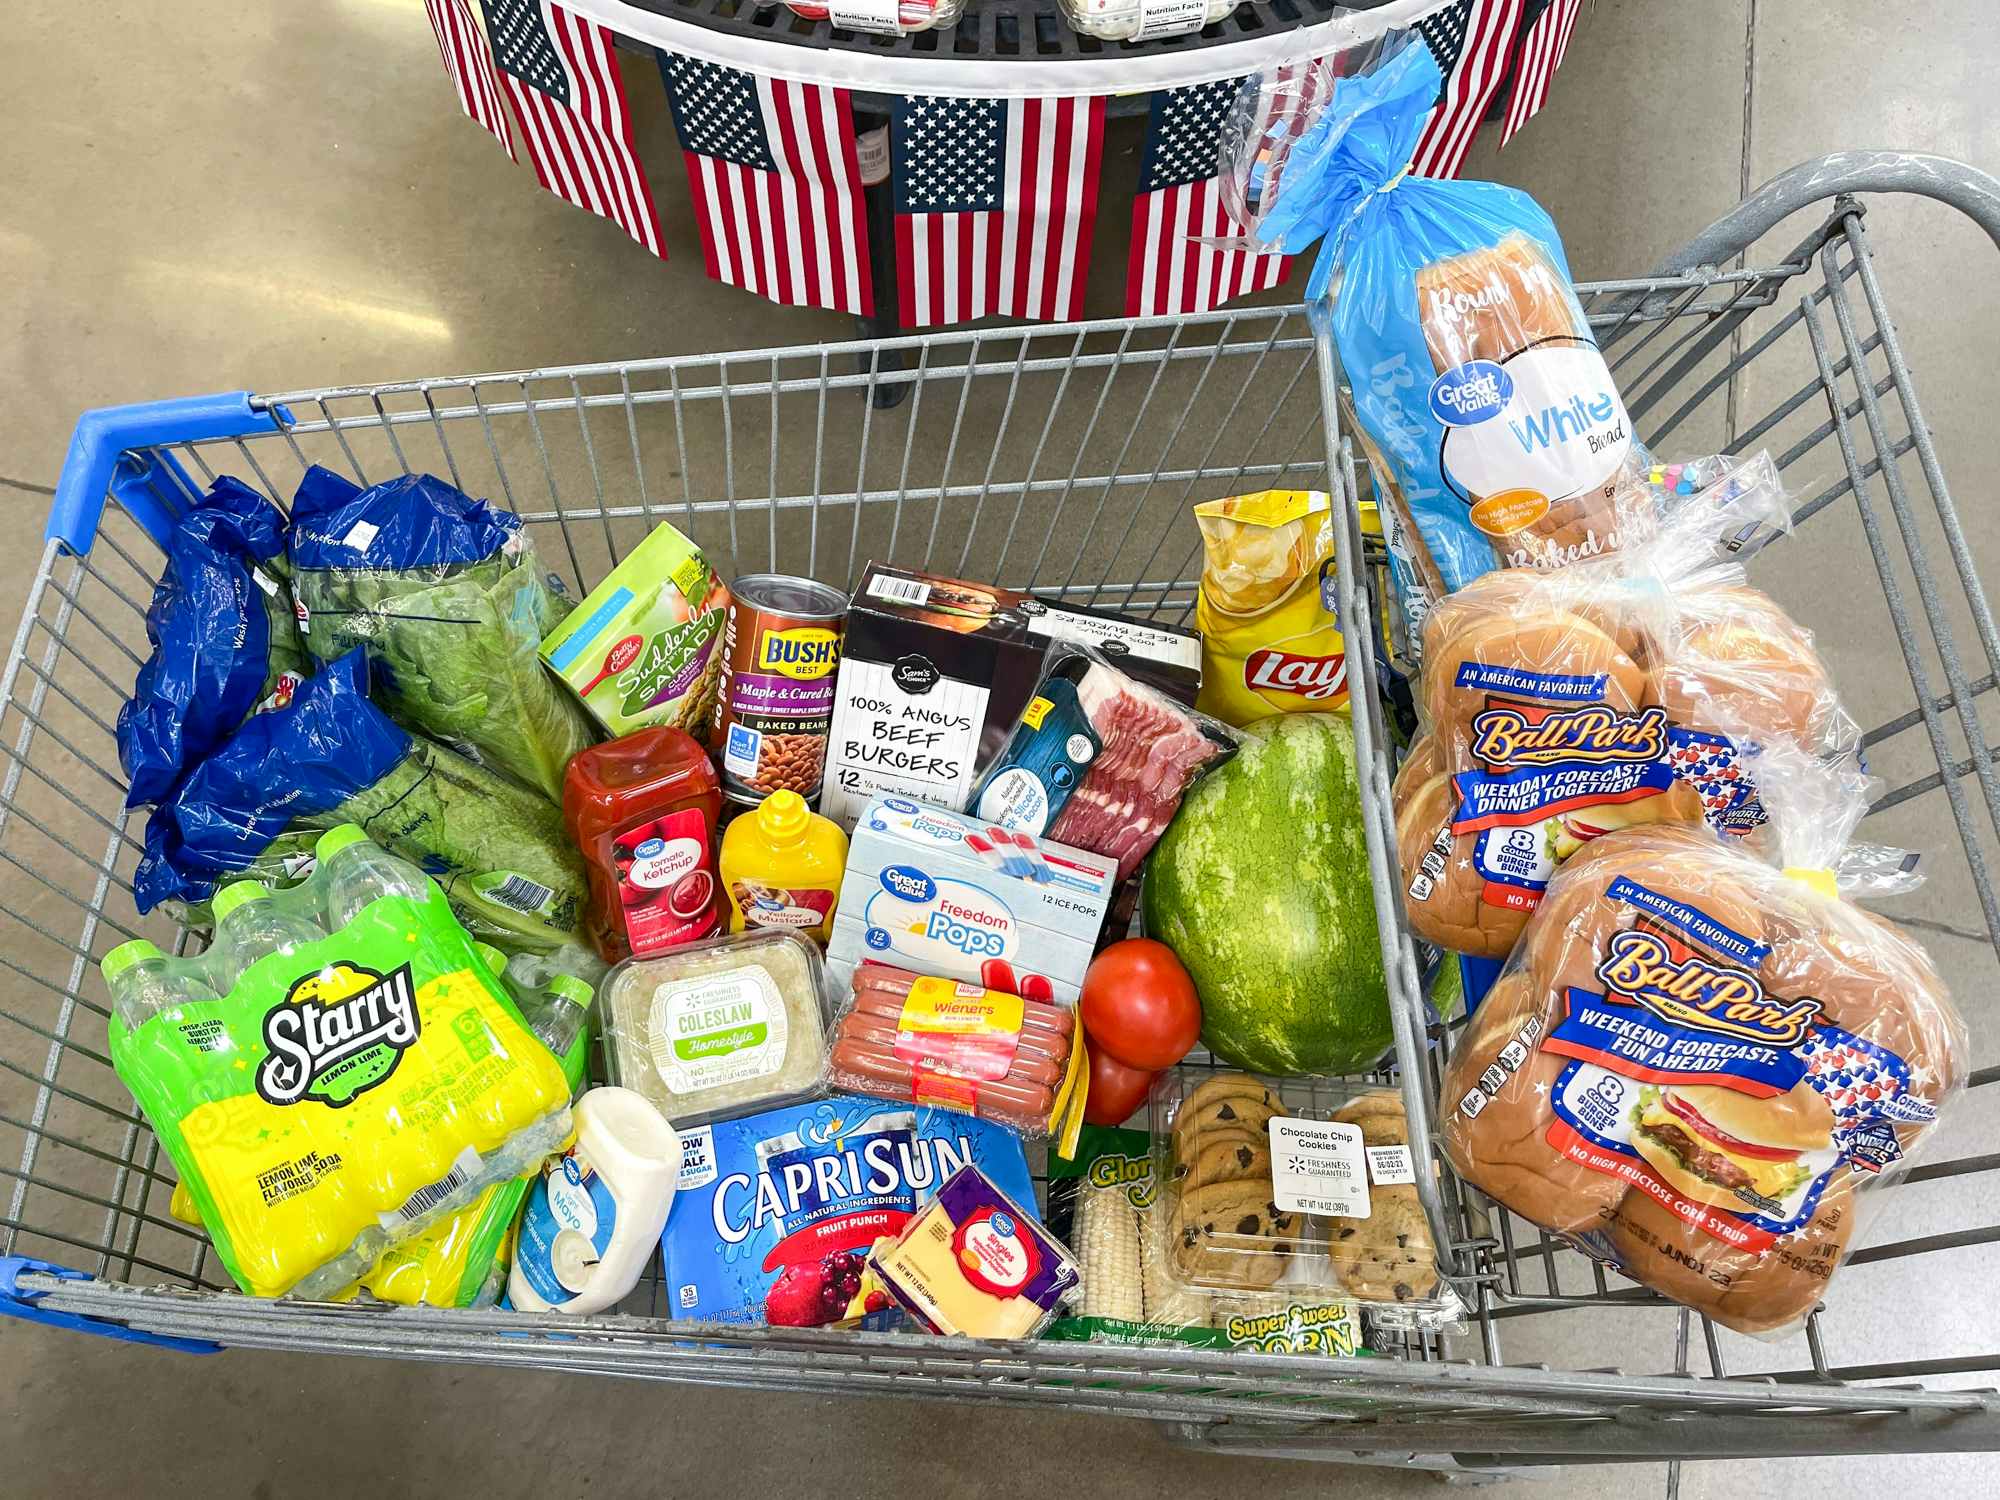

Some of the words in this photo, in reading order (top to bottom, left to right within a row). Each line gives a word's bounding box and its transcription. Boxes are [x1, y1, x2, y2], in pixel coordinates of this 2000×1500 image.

[835, 12, 870, 21] Nutrition
[1146, 6, 1180, 16] Nutrition
[1182, 2, 1203, 10] Facts
[1437, 372, 1498, 406] Great
[1455, 392, 1501, 415] Value
[1508, 392, 1614, 454] White
[1587, 419, 1626, 454] Bread
[1506, 529, 1605, 569] Baked
[233, 622, 248, 649] Wash
[1138, 631, 1179, 645] BEEF
[616, 602, 715, 699] Suddenly
[767, 637, 842, 664] BUSH'S
[640, 628, 711, 700] SALAD
[668, 658, 699, 689] CLASSIC
[795, 665, 818, 675] BEST
[897, 665, 931, 680] Sam's
[1251, 652, 1347, 700] Lay
[741, 683, 772, 700] Maple
[778, 689, 789, 700] &
[791, 687, 822, 700] Cured
[1463, 670, 1478, 681] AN
[1480, 673, 1537, 691] AMERICAN
[1538, 681, 1592, 695] FAVORITE!
[757, 721, 796, 730] BAKED
[800, 721, 828, 730] BEANS
[849, 696, 892, 715] 100%
[902, 705, 971, 731] ANGUS
[873, 721, 945, 748] BEEF
[1480, 715, 1574, 760] Ball
[1567, 712, 1661, 757] Park
[845, 740, 959, 780] BURGERS
[1474, 773, 1552, 800] WEEKDAY
[1554, 764, 1651, 785] FORECAST:
[1477, 791, 1540, 814] DINNER
[1544, 774, 1642, 800] TOGETHER!
[1014, 787, 1037, 818] Sliced
[1023, 795, 1044, 823] Bacon
[1728, 809, 1769, 820] WORLD
[912, 818, 963, 841] Pops
[921, 815, 965, 832] Freedom
[1723, 818, 1760, 827] SERIES
[1501, 845, 1537, 860] COUNT
[1509, 829, 1535, 851] 8
[643, 855, 693, 881] Ketchup
[650, 850, 684, 869] Tomato
[1496, 855, 1538, 870] BURGER
[1501, 863, 1529, 877] BUNS
[886, 868, 929, 893] Great
[895, 882, 928, 899] Value
[1043, 894, 1054, 905] 12
[1054, 897, 1072, 909] ICE
[1072, 901, 1097, 918] POPS
[1506, 894, 1524, 906] NO
[758, 915, 813, 925] Mustard
[939, 900, 1009, 931] Freedom
[1616, 884, 1634, 897] AN
[1635, 892, 1694, 925] AMERICAN
[1692, 917, 1750, 957] FAVORITE!
[872, 930, 885, 941] 12
[928, 912, 1006, 957] Pops
[1607, 938, 1711, 1001] Ball
[1698, 975, 1810, 1040] Park
[678, 1002, 753, 1034] COLESLAW
[934, 1002, 995, 1015] Wieners
[1662, 1000, 1689, 1016] BRAND
[262, 970, 417, 1100] Starry
[687, 1029, 755, 1054] Homestyle
[1579, 1008, 1669, 1049] WEEKEND
[1669, 1039, 1780, 1066] FORECAST:
[320, 1058, 358, 1086] LEMON
[357, 1048, 383, 1065] LIME
[1611, 1036, 1651, 1062] FUN
[1649, 1051, 1729, 1072] AHEAD!
[690, 1067, 705, 1077] NO
[1585, 1087, 1621, 1118] COUNT
[1597, 1075, 1625, 1106] 8
[1576, 1094, 1618, 1130] BURGER
[1577, 1107, 1605, 1133] BUNS
[682, 1137, 704, 1151] OW
[1280, 1127, 1328, 1141] Chocolate
[1331, 1131, 1353, 1143] Chip
[1298, 1139, 1337, 1151] Cookies
[258, 1166, 295, 1190] LEMON
[294, 1151, 320, 1175] LIME
[681, 1155, 707, 1170] ALF
[686, 1164, 713, 1176] SUGAR
[1307, 1159, 1351, 1170] FRESHNESS
[1308, 1168, 1352, 1178] GUARANTEED
[262, 1171, 315, 1202] FLAVORED
[313, 1153, 343, 1174] SODA
[712, 1150, 864, 1244] CAPRI
[864, 1136, 976, 1196] SUN
[266, 1197, 282, 1208] WITH
[1297, 1199, 1308, 1209] NET
[1308, 1200, 1317, 1209] WT
[1317, 1201, 1324, 1210] 14
[1324, 1202, 1333, 1211] OZ
[1569, 1144, 1588, 1160] NO
[1589, 1155, 1618, 1171] HIGH
[1617, 1164, 1672, 1204] FRUCTOSE
[1673, 1200, 1707, 1223] CORN
[1707, 1217, 1749, 1245] SYRUP
[553, 1190, 582, 1230] Mayo
[787, 1218, 804, 1230] ALL
[804, 1203, 848, 1221] NATURAL
[848, 1196, 912, 1209] INGREDIENTS
[816, 1219, 848, 1238] FRUIT
[849, 1214, 888, 1228] PUNCH
[988, 1233, 1015, 1263] Singles
[896, 1261, 906, 1274] NET
[911, 1276, 919, 1285] 12
[917, 1282, 924, 1292] OZ
[1708, 1268, 1732, 1287] 23
[683, 1287, 694, 1298] 35
[1230, 1313, 1287, 1340] Super
[1289, 1302, 1347, 1328] Sweet
[1127, 1333, 1143, 1345] KEEP
[1253, 1325, 1353, 1357] ORN
